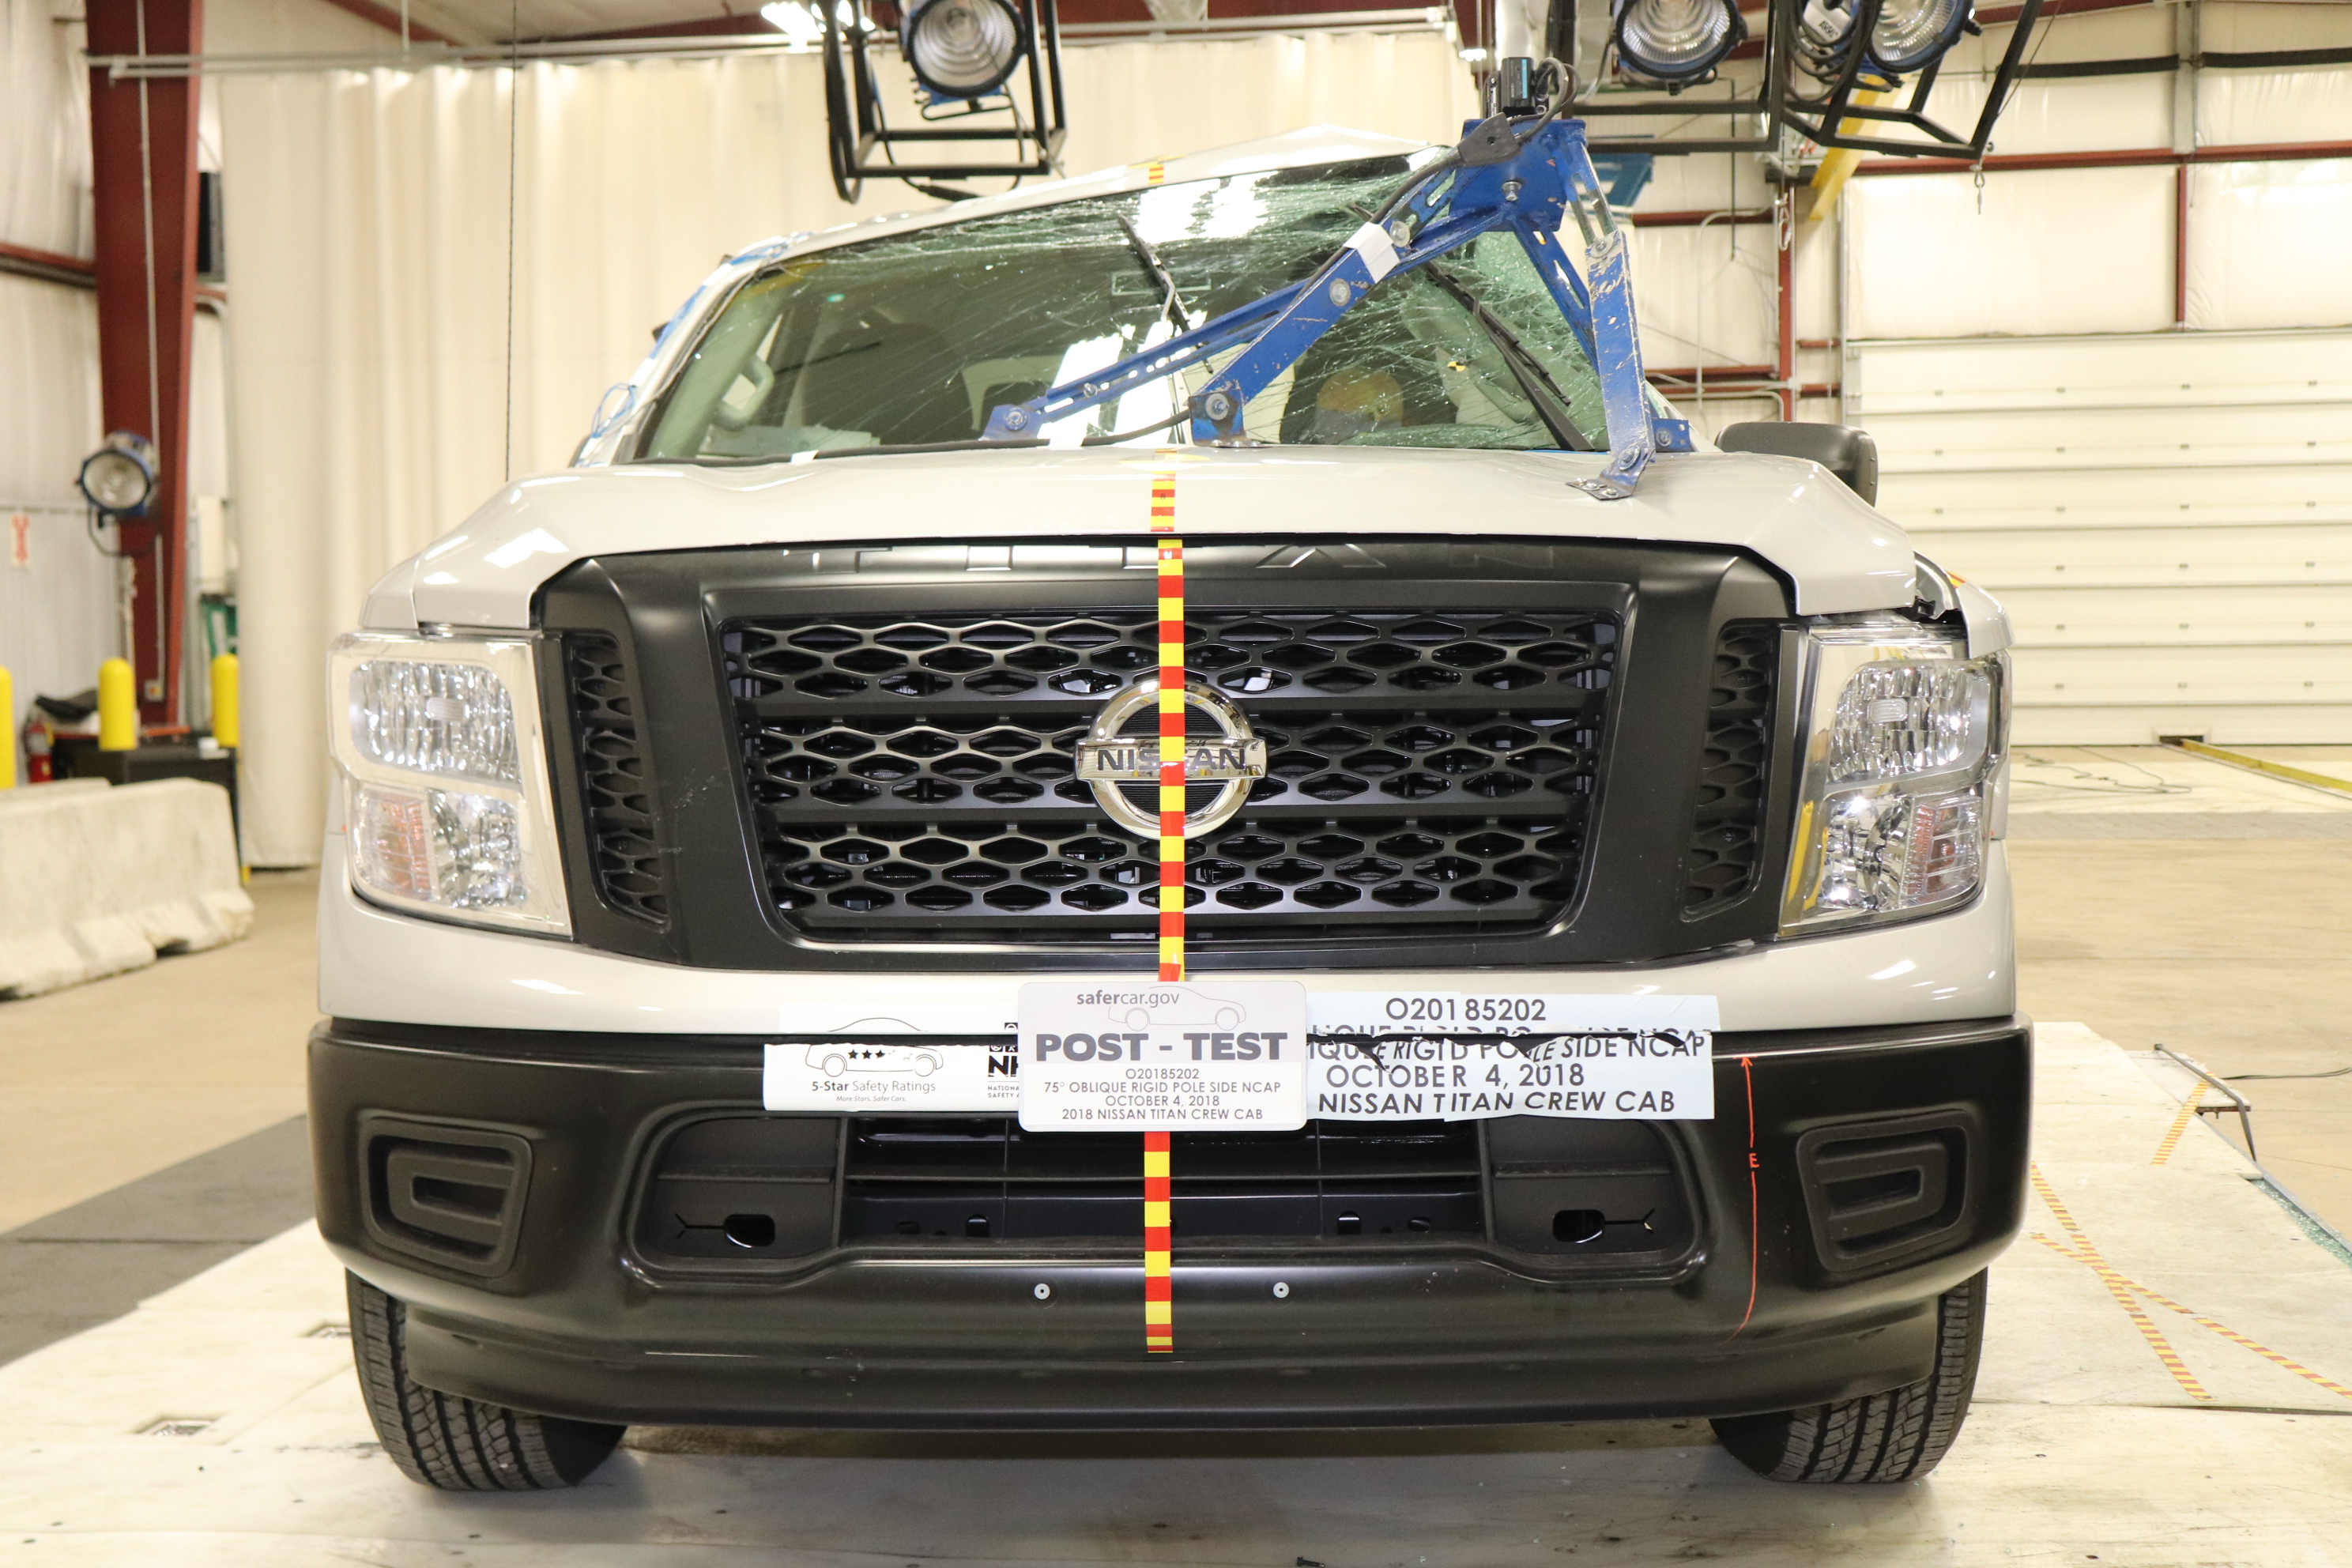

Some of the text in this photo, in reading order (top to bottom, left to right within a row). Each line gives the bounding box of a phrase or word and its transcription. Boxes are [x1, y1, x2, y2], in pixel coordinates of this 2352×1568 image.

[1097, 748, 1246, 771] NISAN
[1076, 989, 1181, 1008] safercar.gov
[1036, 1033, 1149, 1061] POST
[1183, 1031, 1288, 1061] TEST
[1561, 1030, 1618, 1057] SIDE
[1628, 1029, 1705, 1057] NCAP
[1326, 1063, 1585, 1090] OCTOBER 4, 2018
[812, 1080, 936, 1095] 5-Star Safety Ratings
[1044, 1081, 1281, 1094] 75° OBLIQUE RIGID POLE SIDE NCAP
[1105, 1095, 1220, 1108] OCTOBER 4, 2018
[1318, 1091, 1675, 1114] NISSAN TITAN CREW CAB
[1061, 1108, 1263, 1120] 2018 NISSAN TITAN CREW CAB
[1749, 1152, 1760, 1168] E
